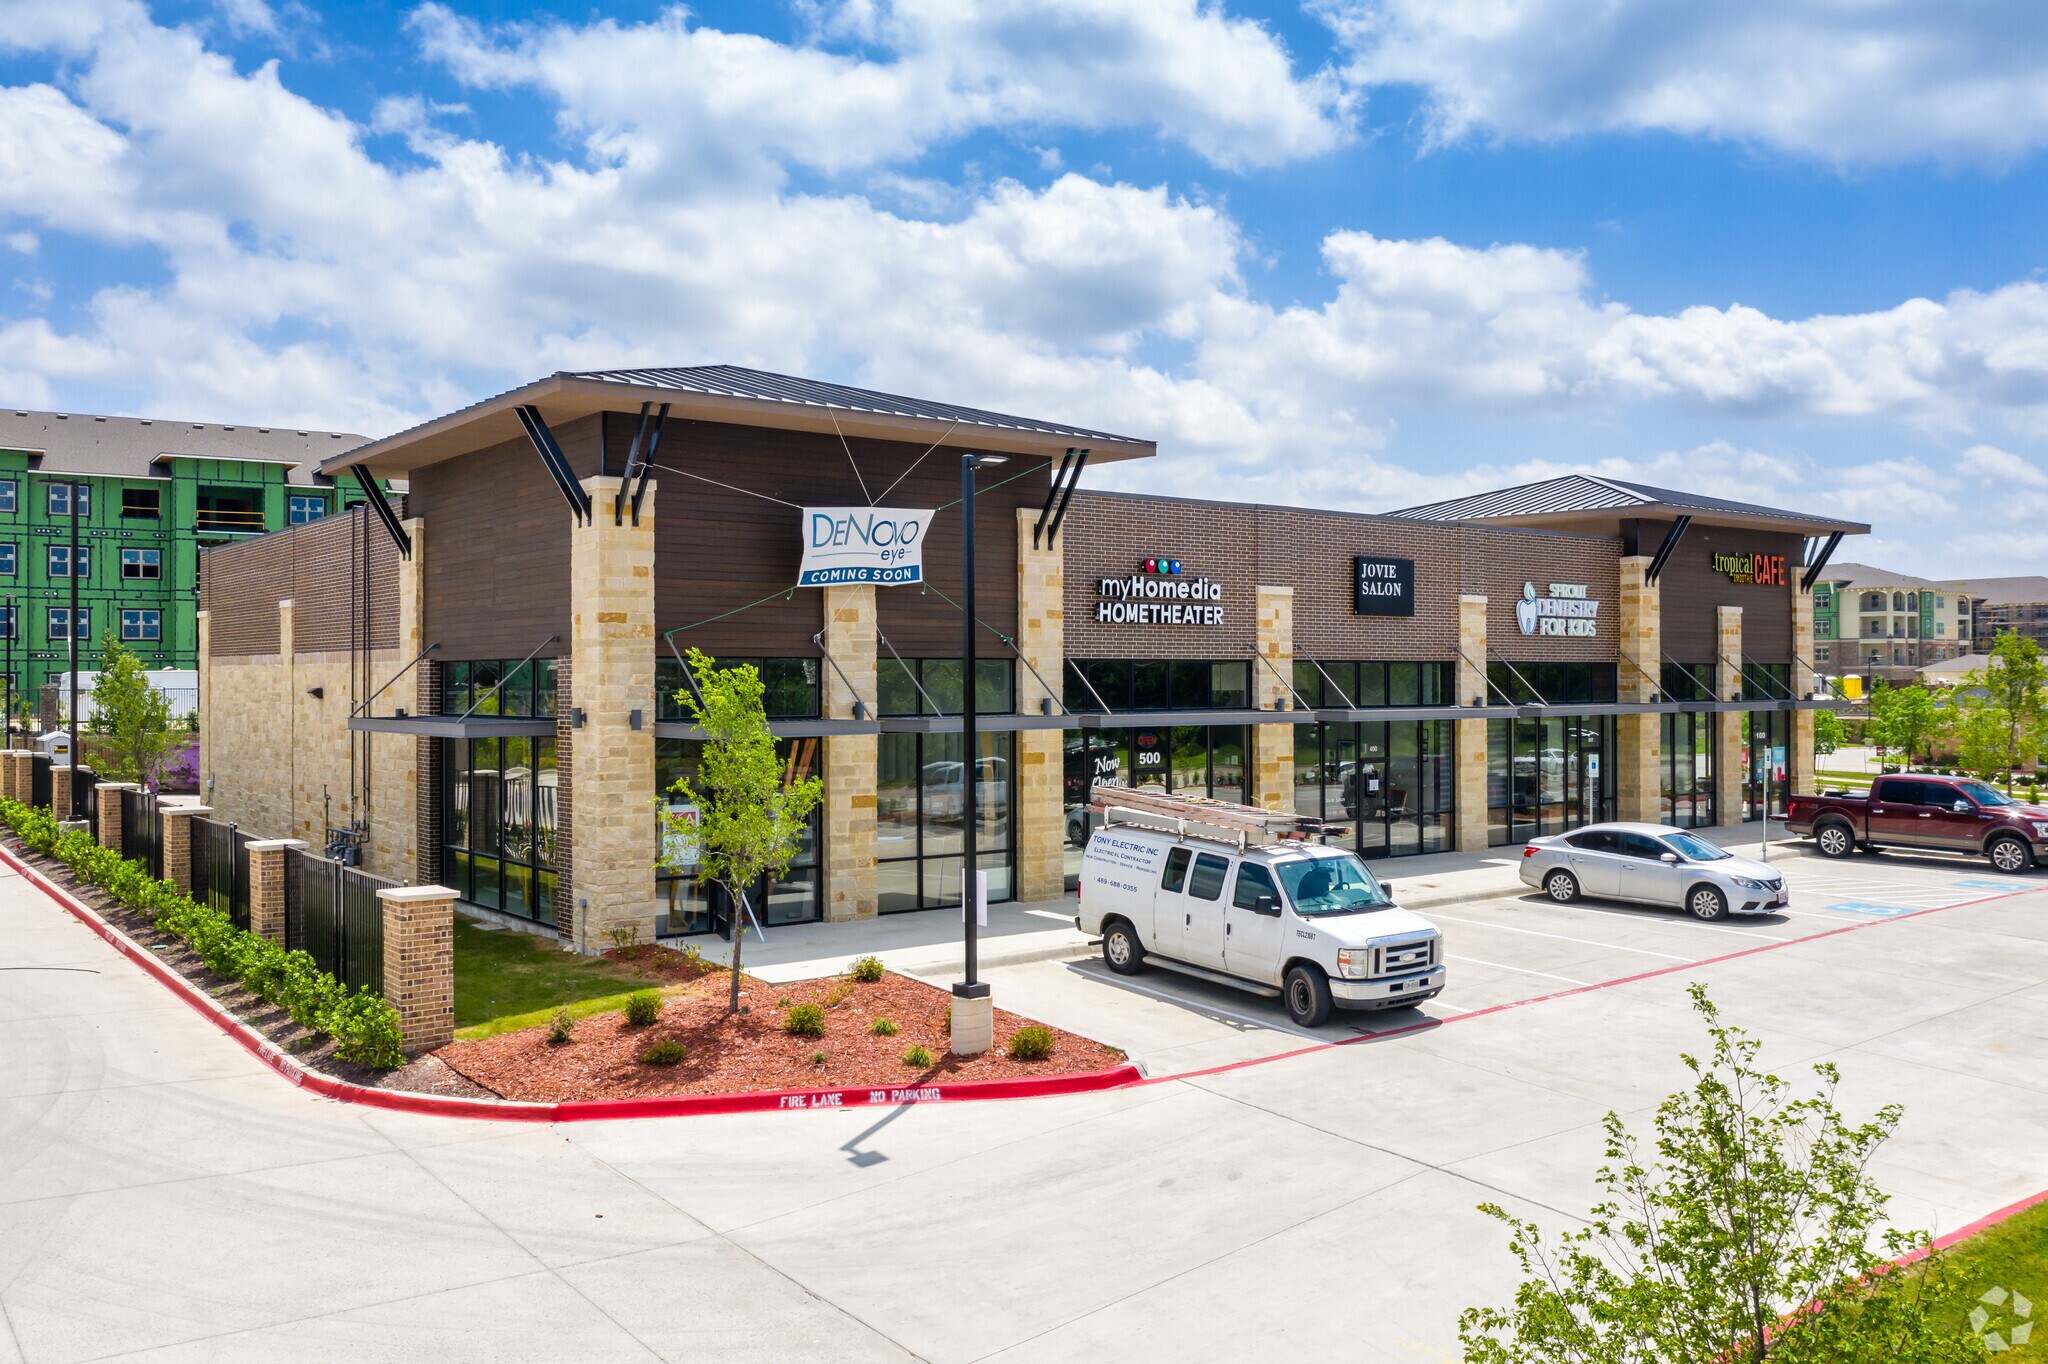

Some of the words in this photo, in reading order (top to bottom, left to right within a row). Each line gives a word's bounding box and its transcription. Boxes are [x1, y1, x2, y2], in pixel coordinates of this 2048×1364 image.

[881, 548, 905, 565] eye
[811, 568, 867, 582] COMING
[872, 568, 912, 581] SOON
[1361, 563, 1396, 578] JOVIE
[1715, 552, 1753, 576] tropical
[1755, 554, 1785, 585] CAFE
[1102, 576, 1221, 601] myHomedia
[1362, 582, 1401, 596] SALON
[1549, 583, 1587, 598] SPROUT
[1099, 602, 1223, 624] HOMETHEATER
[1537, 599, 1599, 617] DENTISTRY
[1540, 618, 1567, 636] FOR
[1567, 619, 1597, 636] KIDS
[1095, 756, 1120, 775] Now
[1139, 752, 1161, 764] 500
[1094, 836, 1111, 845] TONY
[1112, 839, 1146, 853] ELECTRIC
[1146, 848, 1159, 856] INC
[1094, 847, 1119, 858] ELECTRICAL
[1120, 853, 1151, 865] CONTRACTOR
[780, 1095, 807, 1108] FIRE
[812, 1093, 843, 1107] LANE
[870, 1090, 886, 1104] NO
[891, 1087, 940, 1102] PARKING
